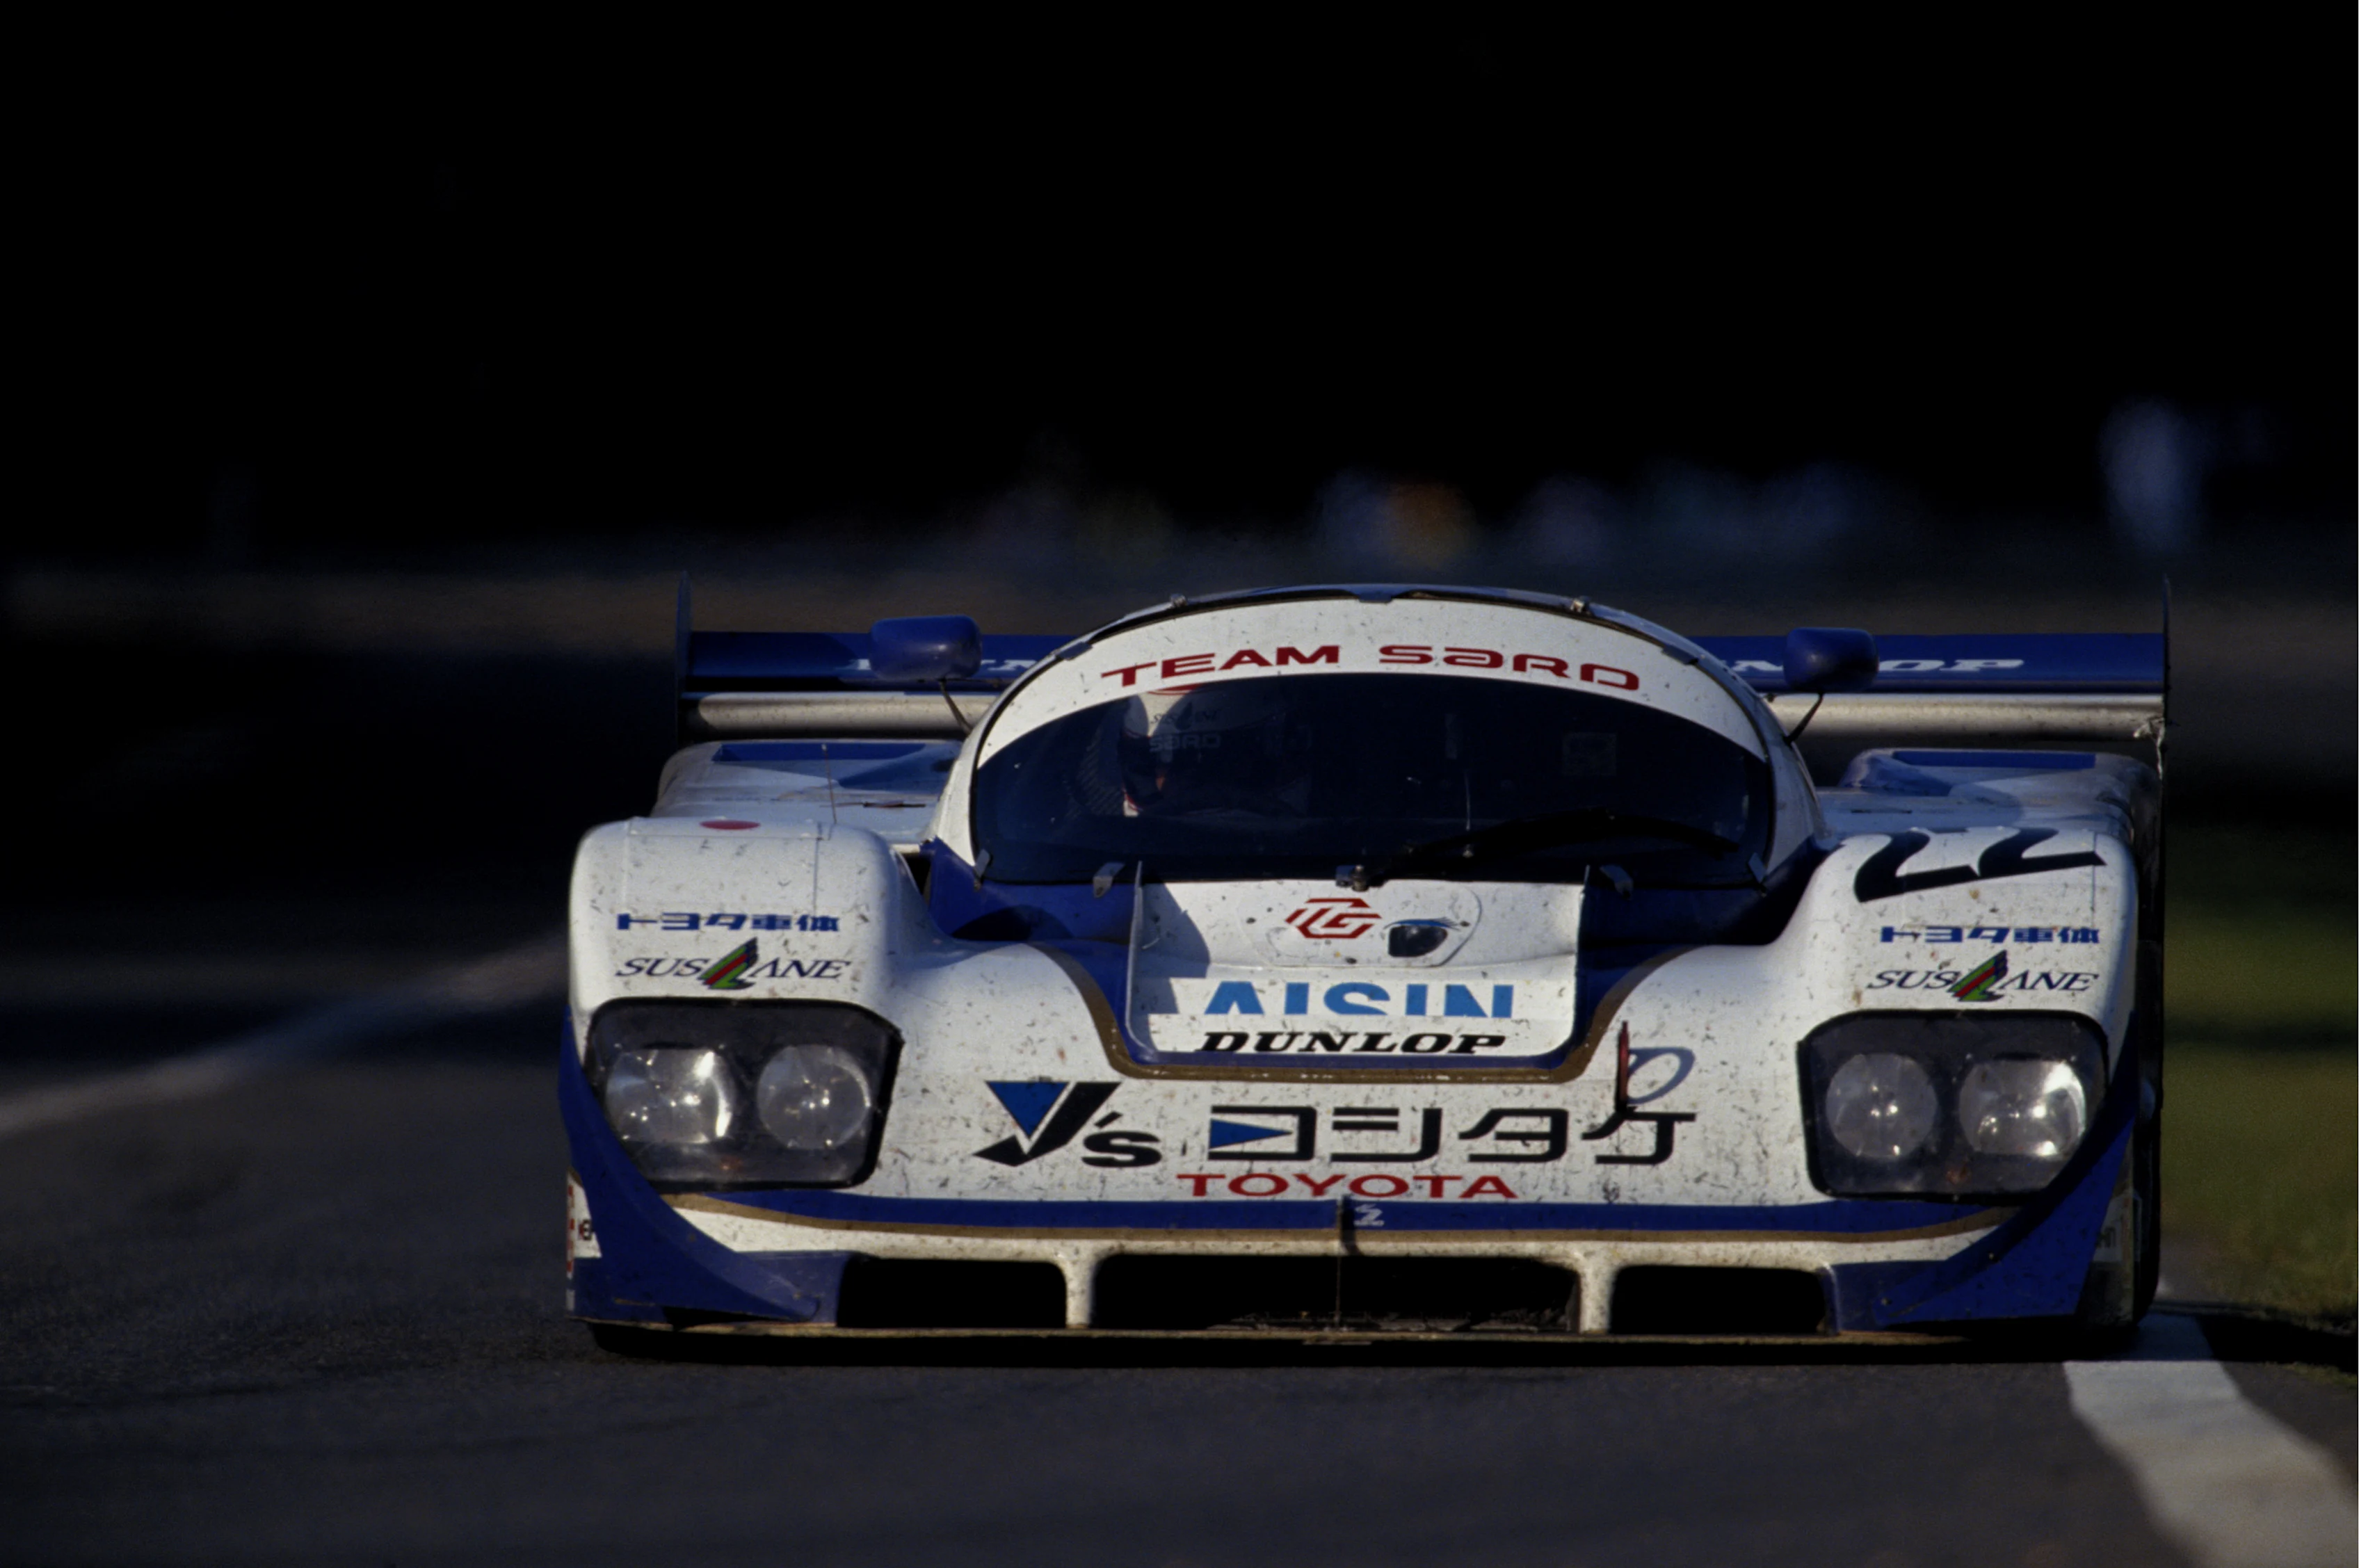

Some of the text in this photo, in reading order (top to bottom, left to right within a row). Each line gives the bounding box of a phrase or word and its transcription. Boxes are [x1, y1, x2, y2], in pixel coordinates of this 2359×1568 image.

[1101, 645, 1341, 687] TEAM
[1853, 826, 2107, 903] 22
[617, 912, 840, 932] トヨタ車体
[1880, 925, 2100, 944] トヨタ車体
[1204, 980, 1514, 1019] AISIN
[1194, 1031, 1506, 1054] DUNLOP
[1207, 1104, 1697, 1165] ヨシタケ
[1176, 1172, 1519, 1199] TOYOTA
